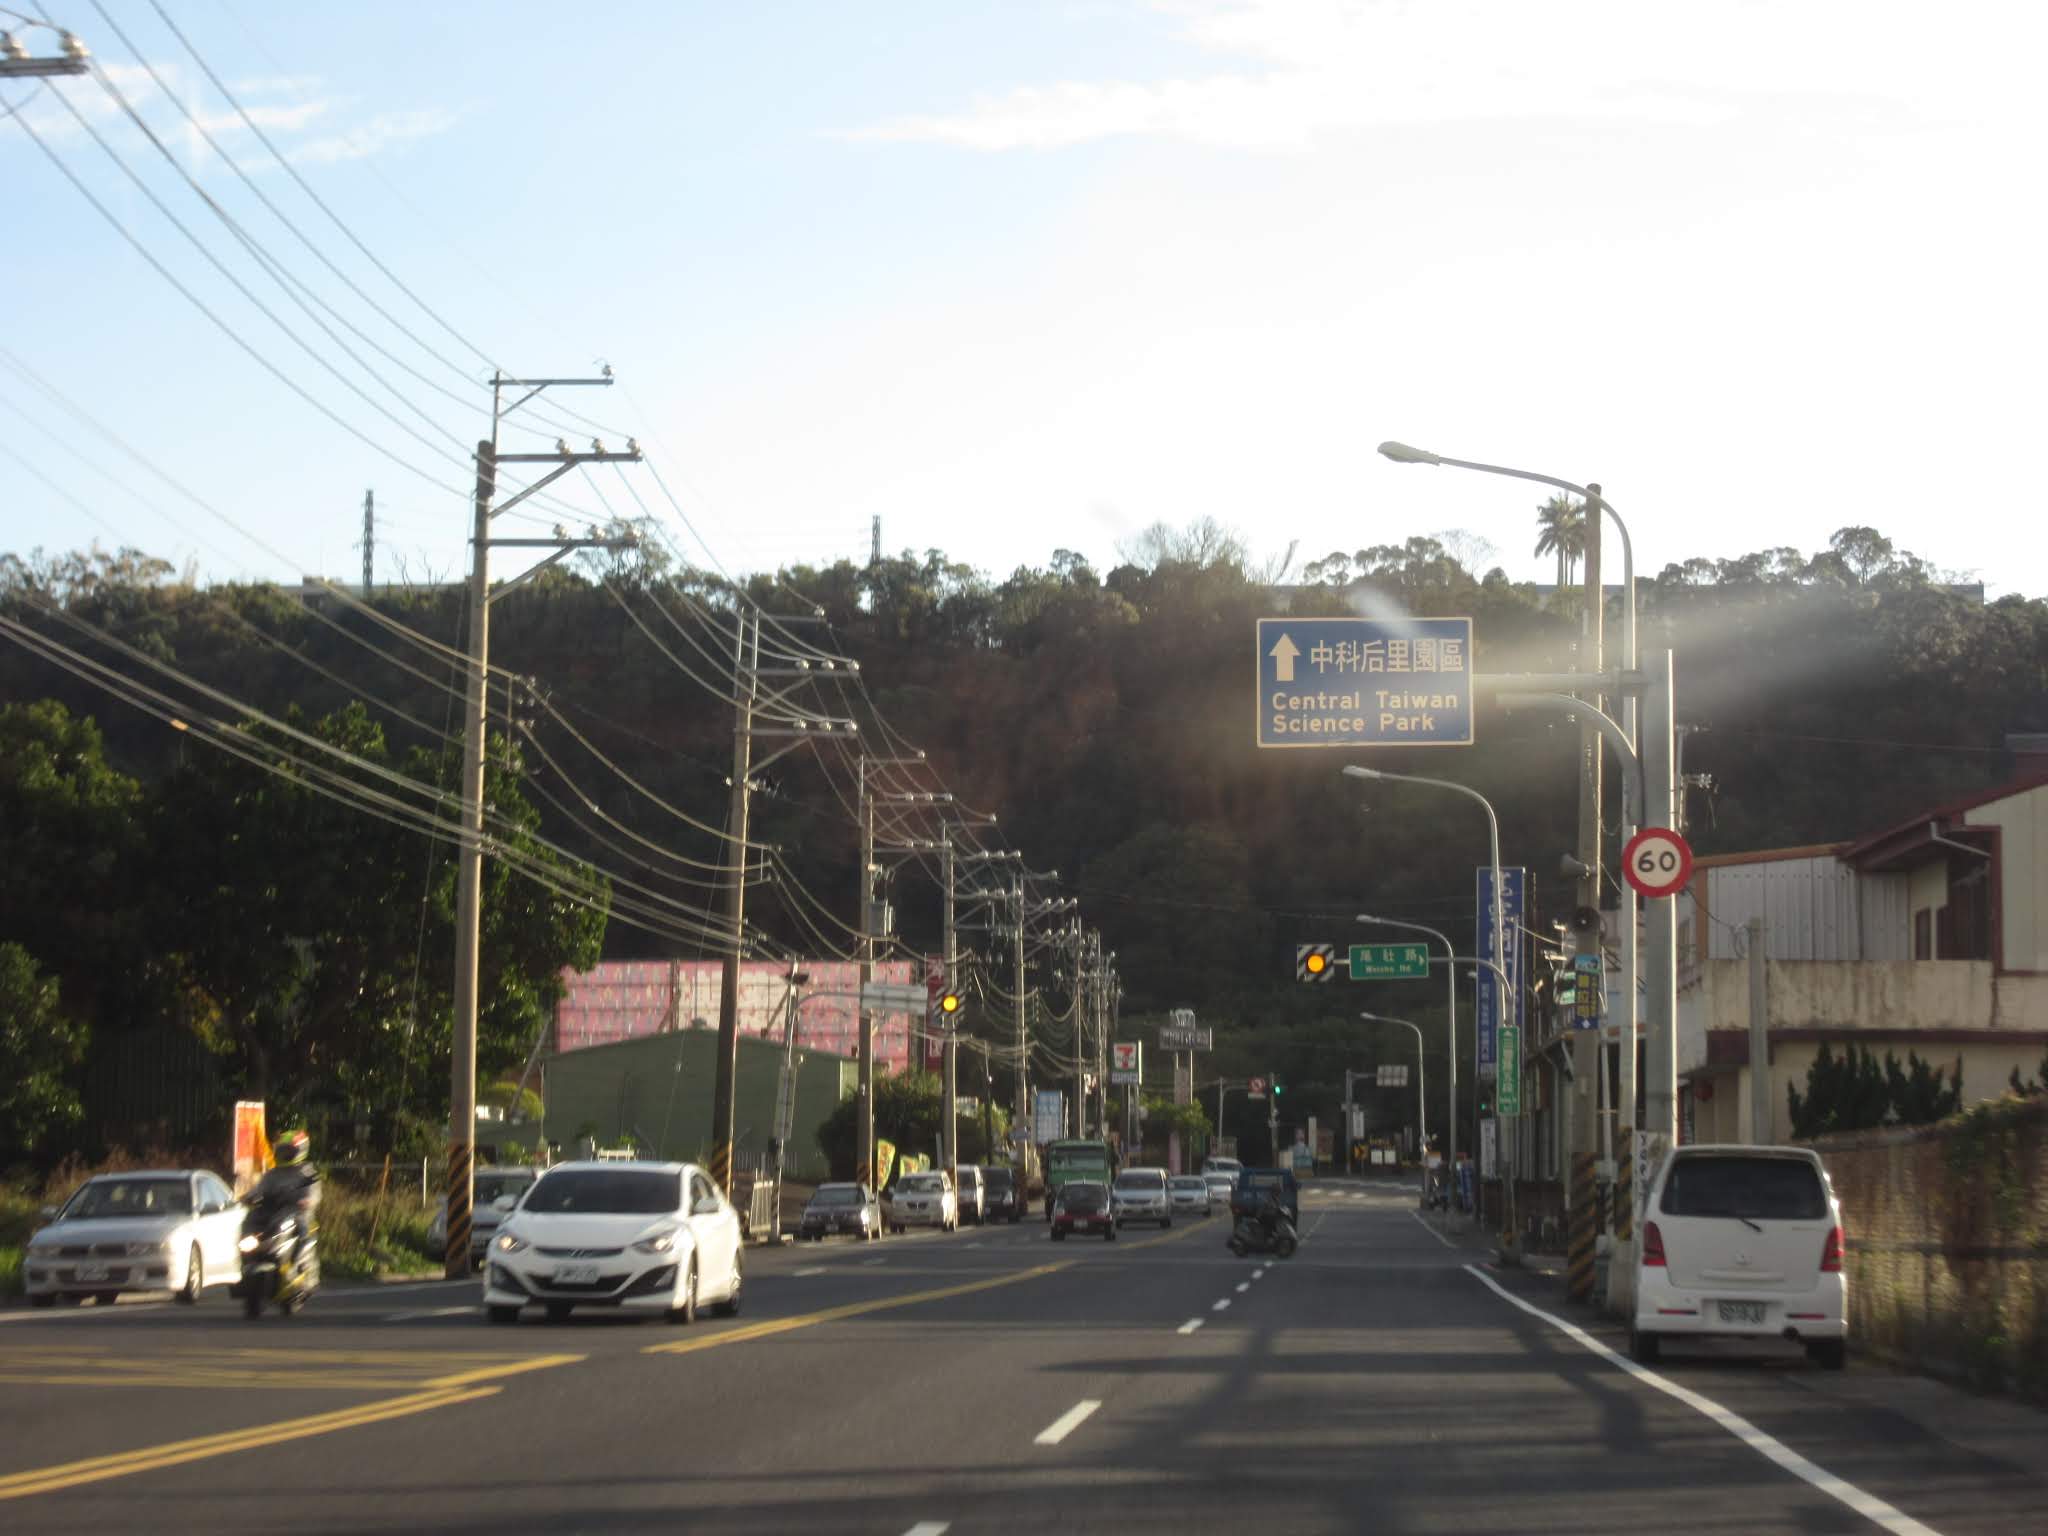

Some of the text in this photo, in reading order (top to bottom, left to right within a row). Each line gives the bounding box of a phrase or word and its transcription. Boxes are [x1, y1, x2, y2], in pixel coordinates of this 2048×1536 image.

[1311, 638, 1464, 673] 中科后里園區
[1272, 690, 1458, 710] Central Taiwan
[1273, 713, 1435, 733] Science Park
[1638, 850, 1676, 872] 60
